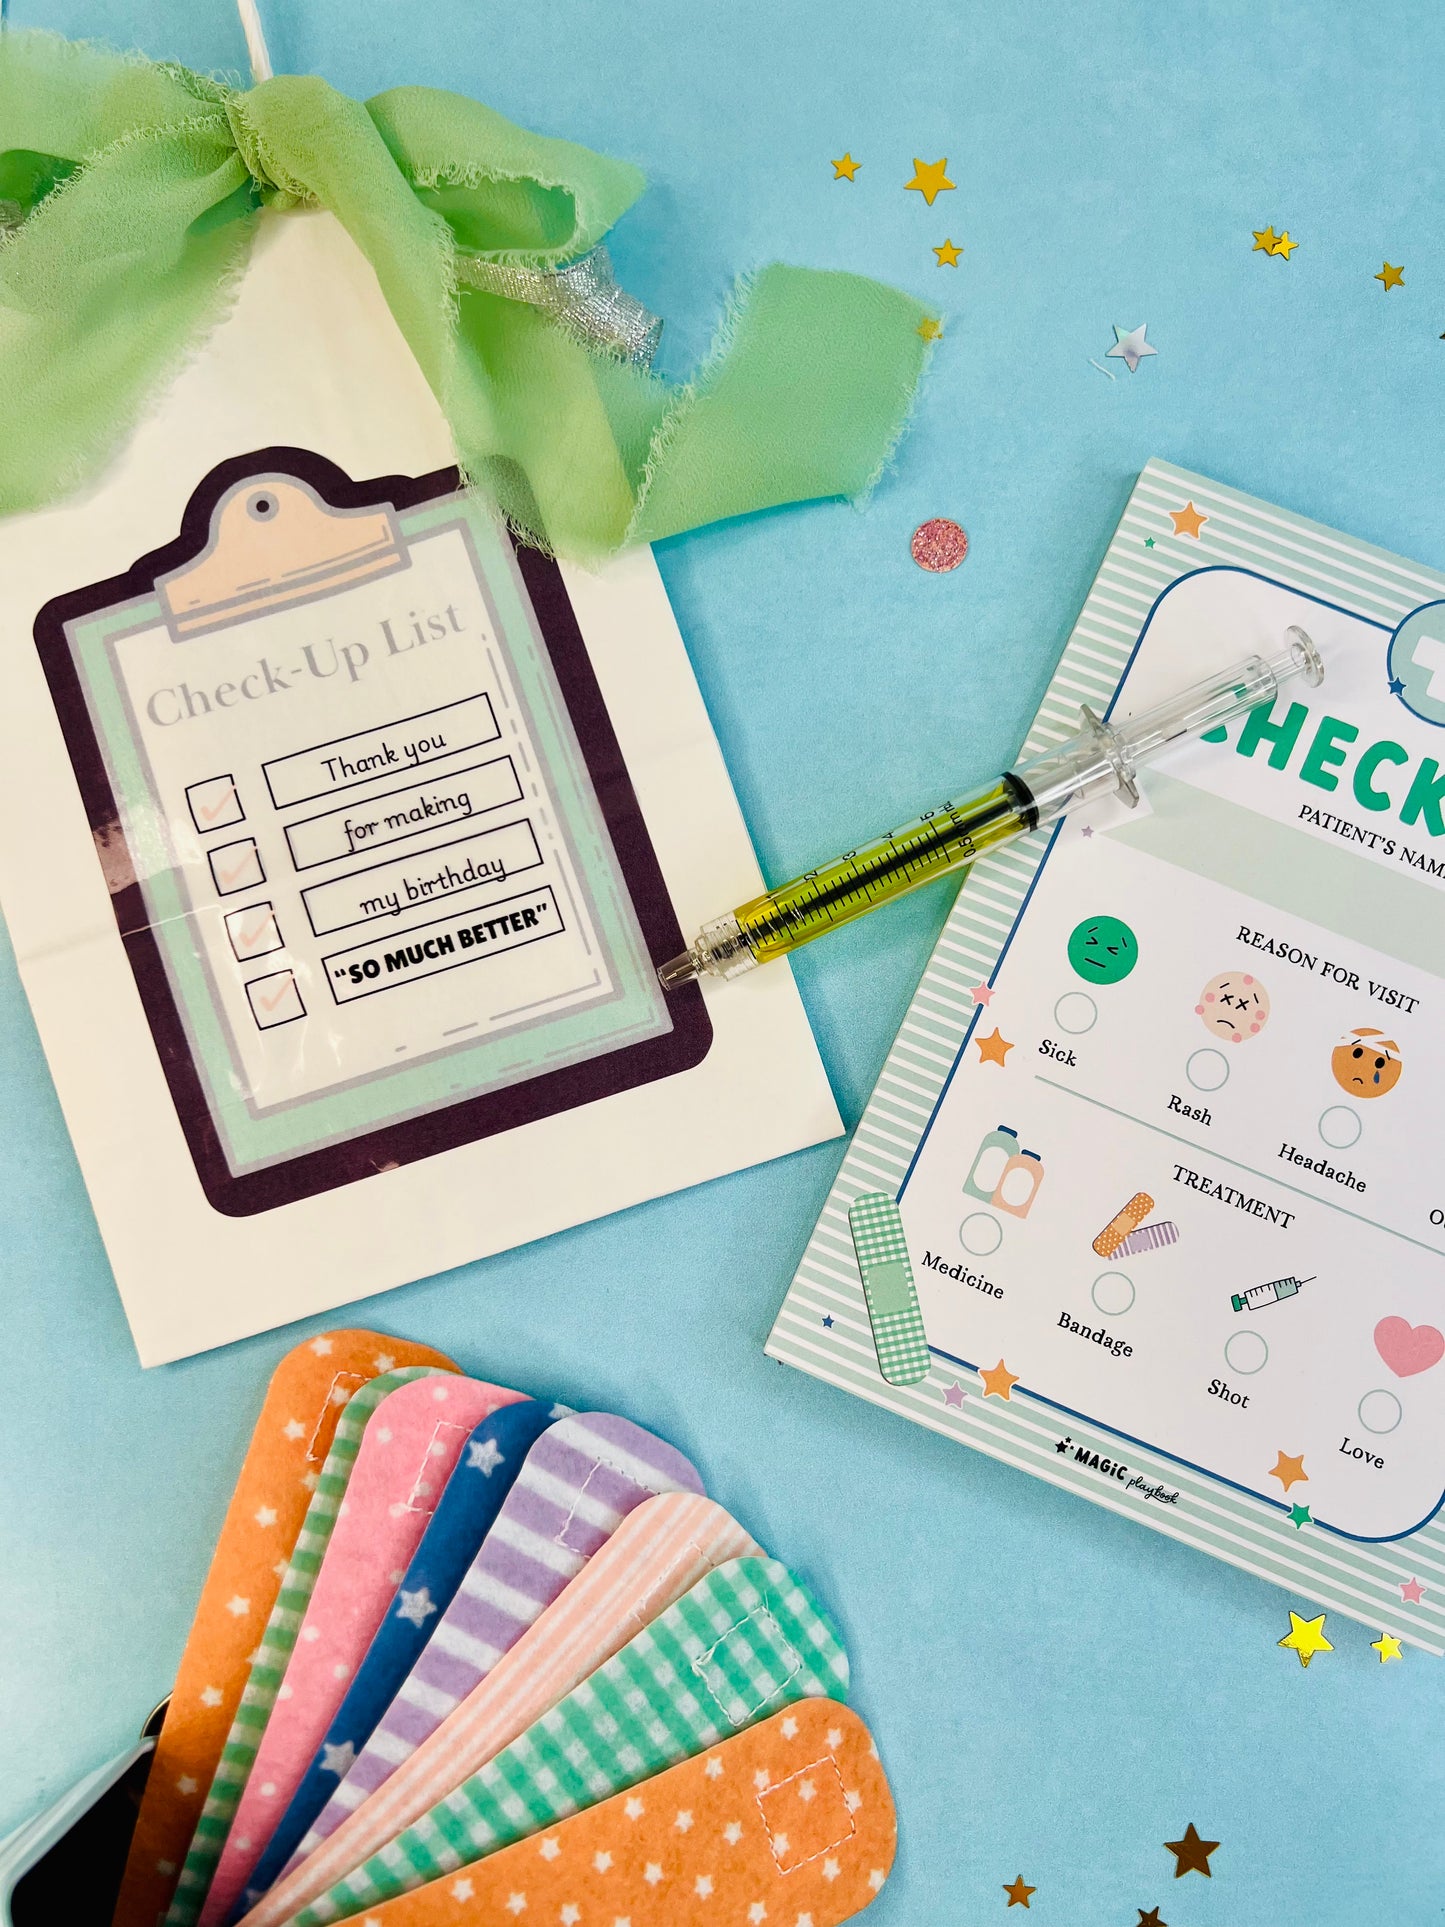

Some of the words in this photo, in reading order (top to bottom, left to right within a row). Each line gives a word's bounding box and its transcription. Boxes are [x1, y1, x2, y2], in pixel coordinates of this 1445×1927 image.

[146, 638, 370, 727] Check-Up
[379, 604, 466, 656] List
[320, 742, 400, 781] Thank
[404, 735, 446, 766] you
[344, 819, 379, 852] for
[384, 793, 472, 829] making
[920, 811, 935, 822] 5
[842, 851, 857, 862] 3
[1298, 804, 1397, 855] PATIENT’S
[1399, 847, 1445, 879] NAM
[360, 892, 401, 916] my
[403, 858, 506, 900] birthday
[803, 870, 818, 883] 2
[334, 958, 380, 984] “SO
[384, 934, 455, 973] MUCH
[457, 902, 548, 949] BETTER”
[1236, 926, 1318, 970] REASON
[1320, 962, 1360, 990] FOR
[1368, 980, 1420, 1014] VISIT
[1038, 1039, 1077, 1067] Sick
[1167, 1094, 1212, 1126] Rash
[1278, 1143, 1367, 1193] Headache
[1173, 1164, 1296, 1229] TREATMENT
[921, 1251, 1004, 1299] Medicine
[1057, 1312, 1133, 1358] Bandage
[1207, 1379, 1250, 1409] Shot
[1338, 1438, 1385, 1469] Love
[1125, 1475, 1179, 1504] playbook
